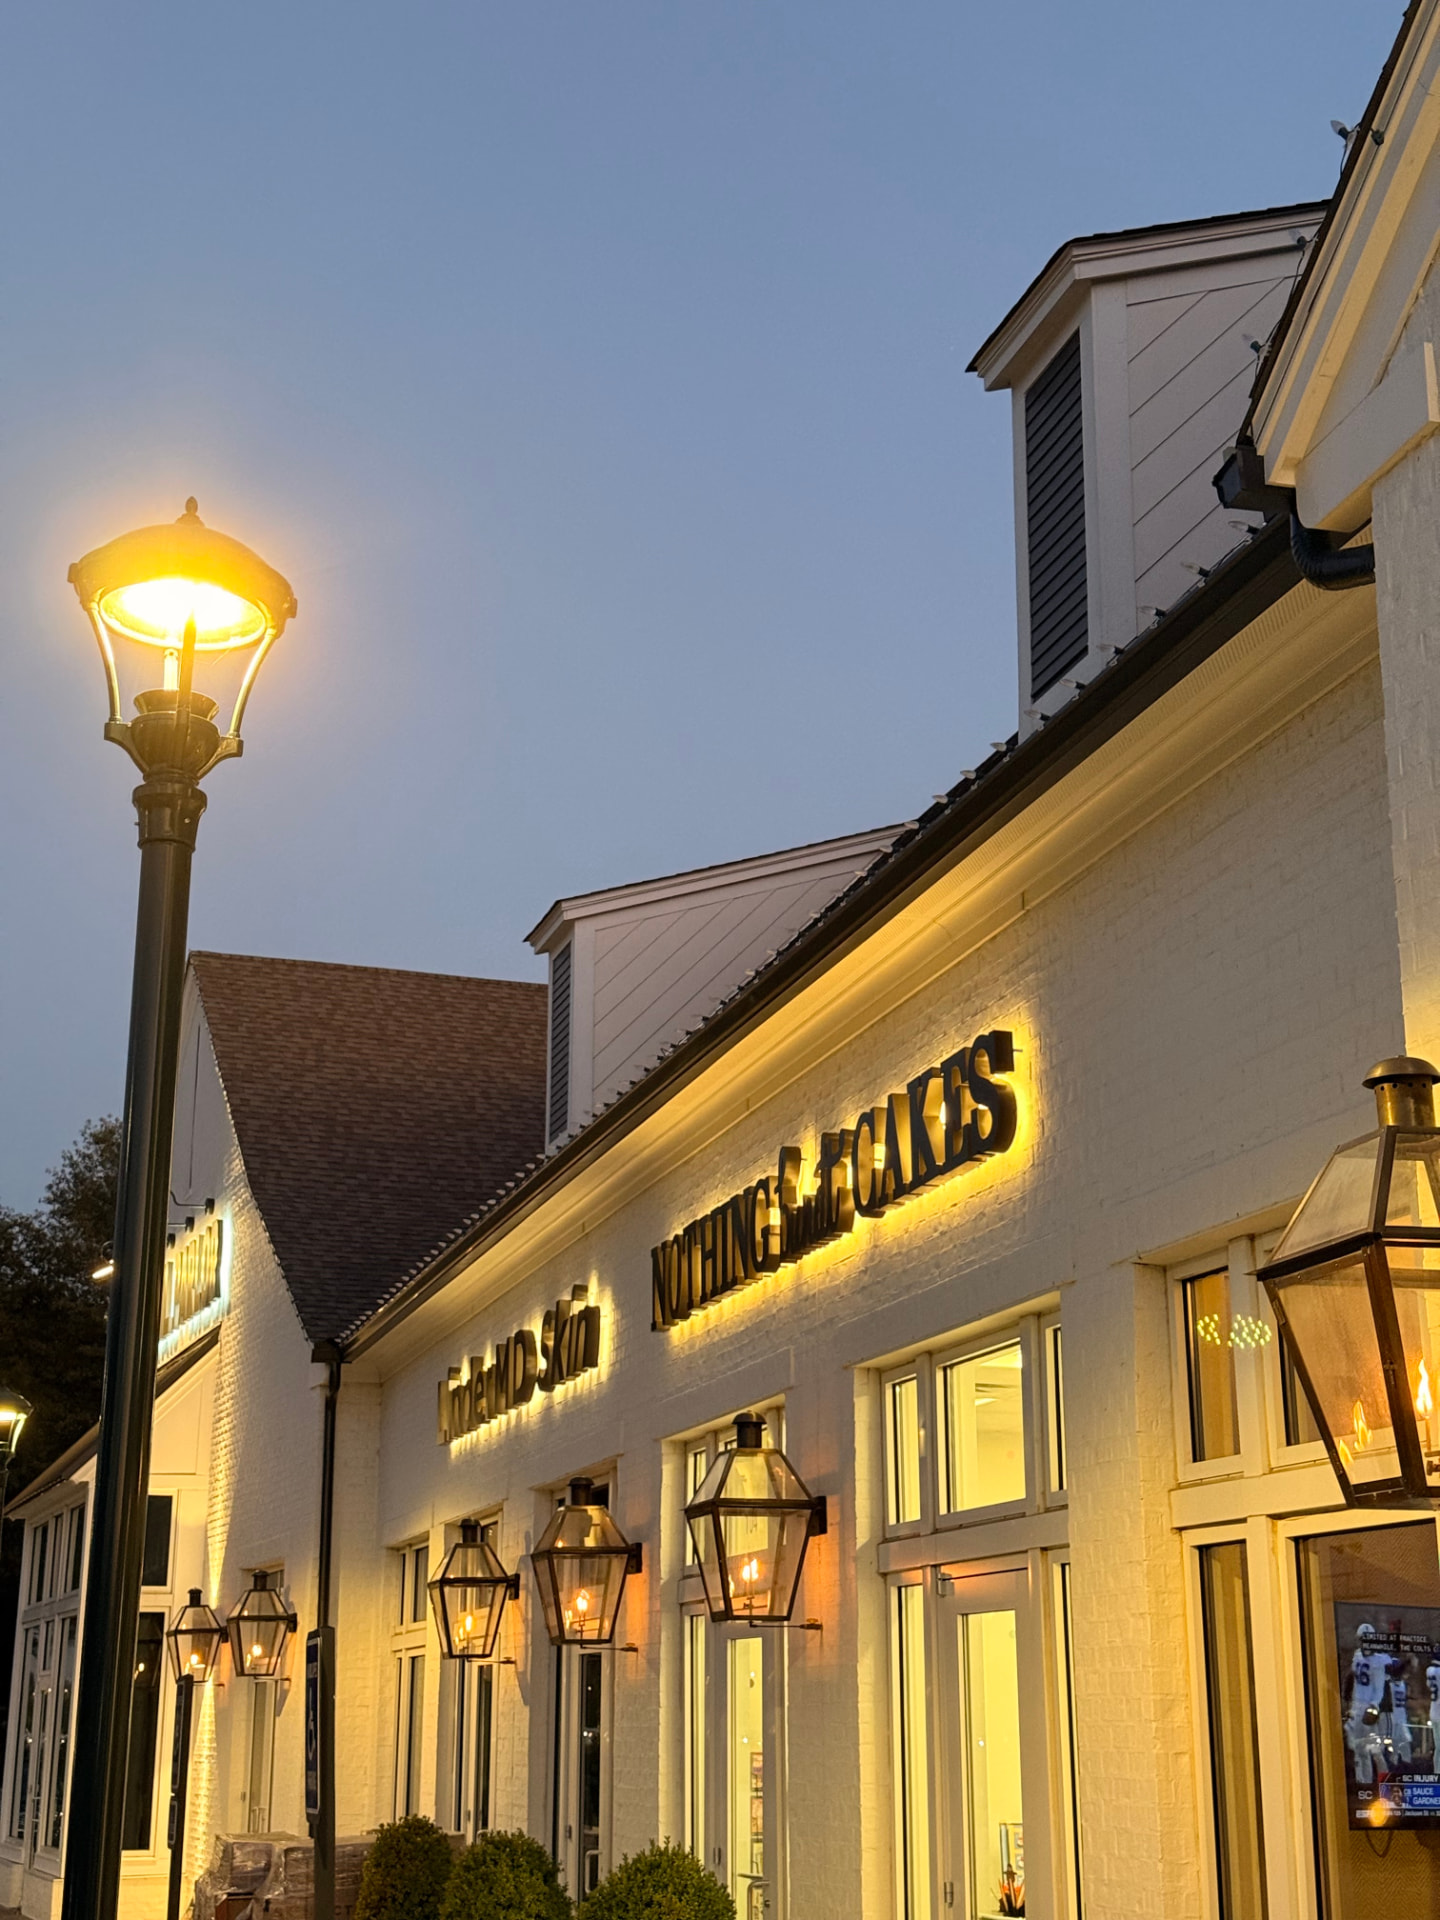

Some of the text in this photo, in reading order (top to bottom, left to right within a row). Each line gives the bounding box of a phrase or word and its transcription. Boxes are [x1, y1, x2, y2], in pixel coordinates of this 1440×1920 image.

[651, 1175, 780, 1332] NOTHING
[852, 1030, 1018, 1218] CAKES
[1358, 1791, 1373, 1799] SC
[1413, 1787, 1434, 1795] SAUCE
